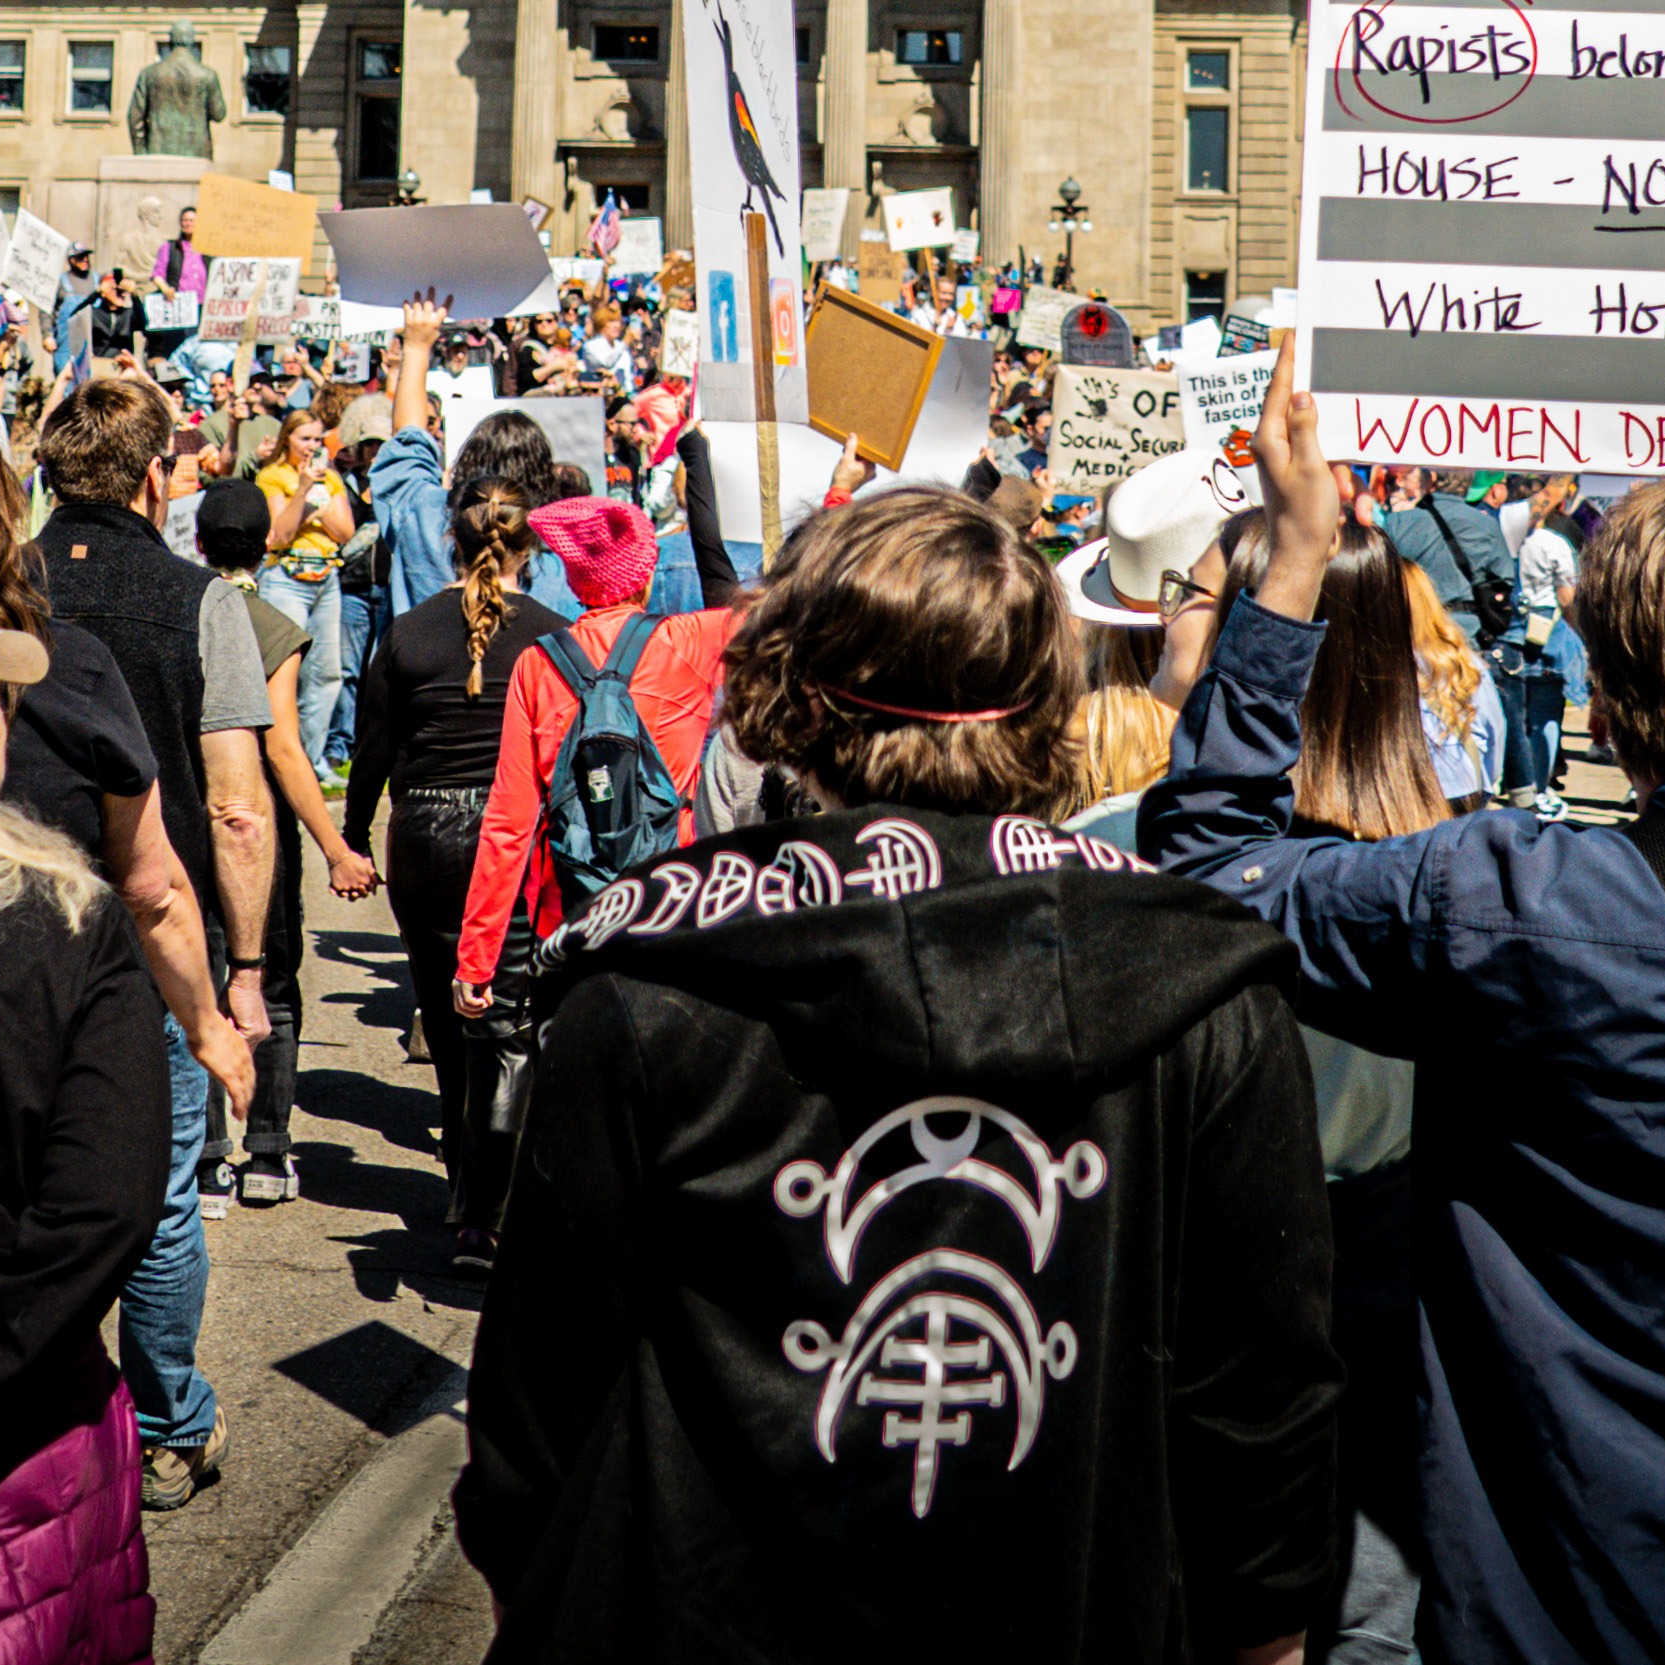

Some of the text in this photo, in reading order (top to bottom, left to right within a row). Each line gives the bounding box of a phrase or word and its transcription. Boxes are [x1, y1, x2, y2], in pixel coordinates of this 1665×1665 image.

[1352, 9, 1530, 104] Rapists
[1357, 144, 1521, 202] HOUSE
[1374, 278, 1542, 339] White
[290, 321, 386, 344] CONSTITION
[1188, 375, 1227, 392] This
[1233, 371, 1247, 385] is
[1133, 389, 1180, 418] OF
[1198, 391, 1235, 408] skin
[1241, 385, 1257, 401] of
[1204, 403, 1263, 424] fascist
[1059, 419, 1185, 457] SOCIAL SECURI
[1355, 396, 1591, 465] WOMEN
[1071, 458, 1135, 477] MEDIC
